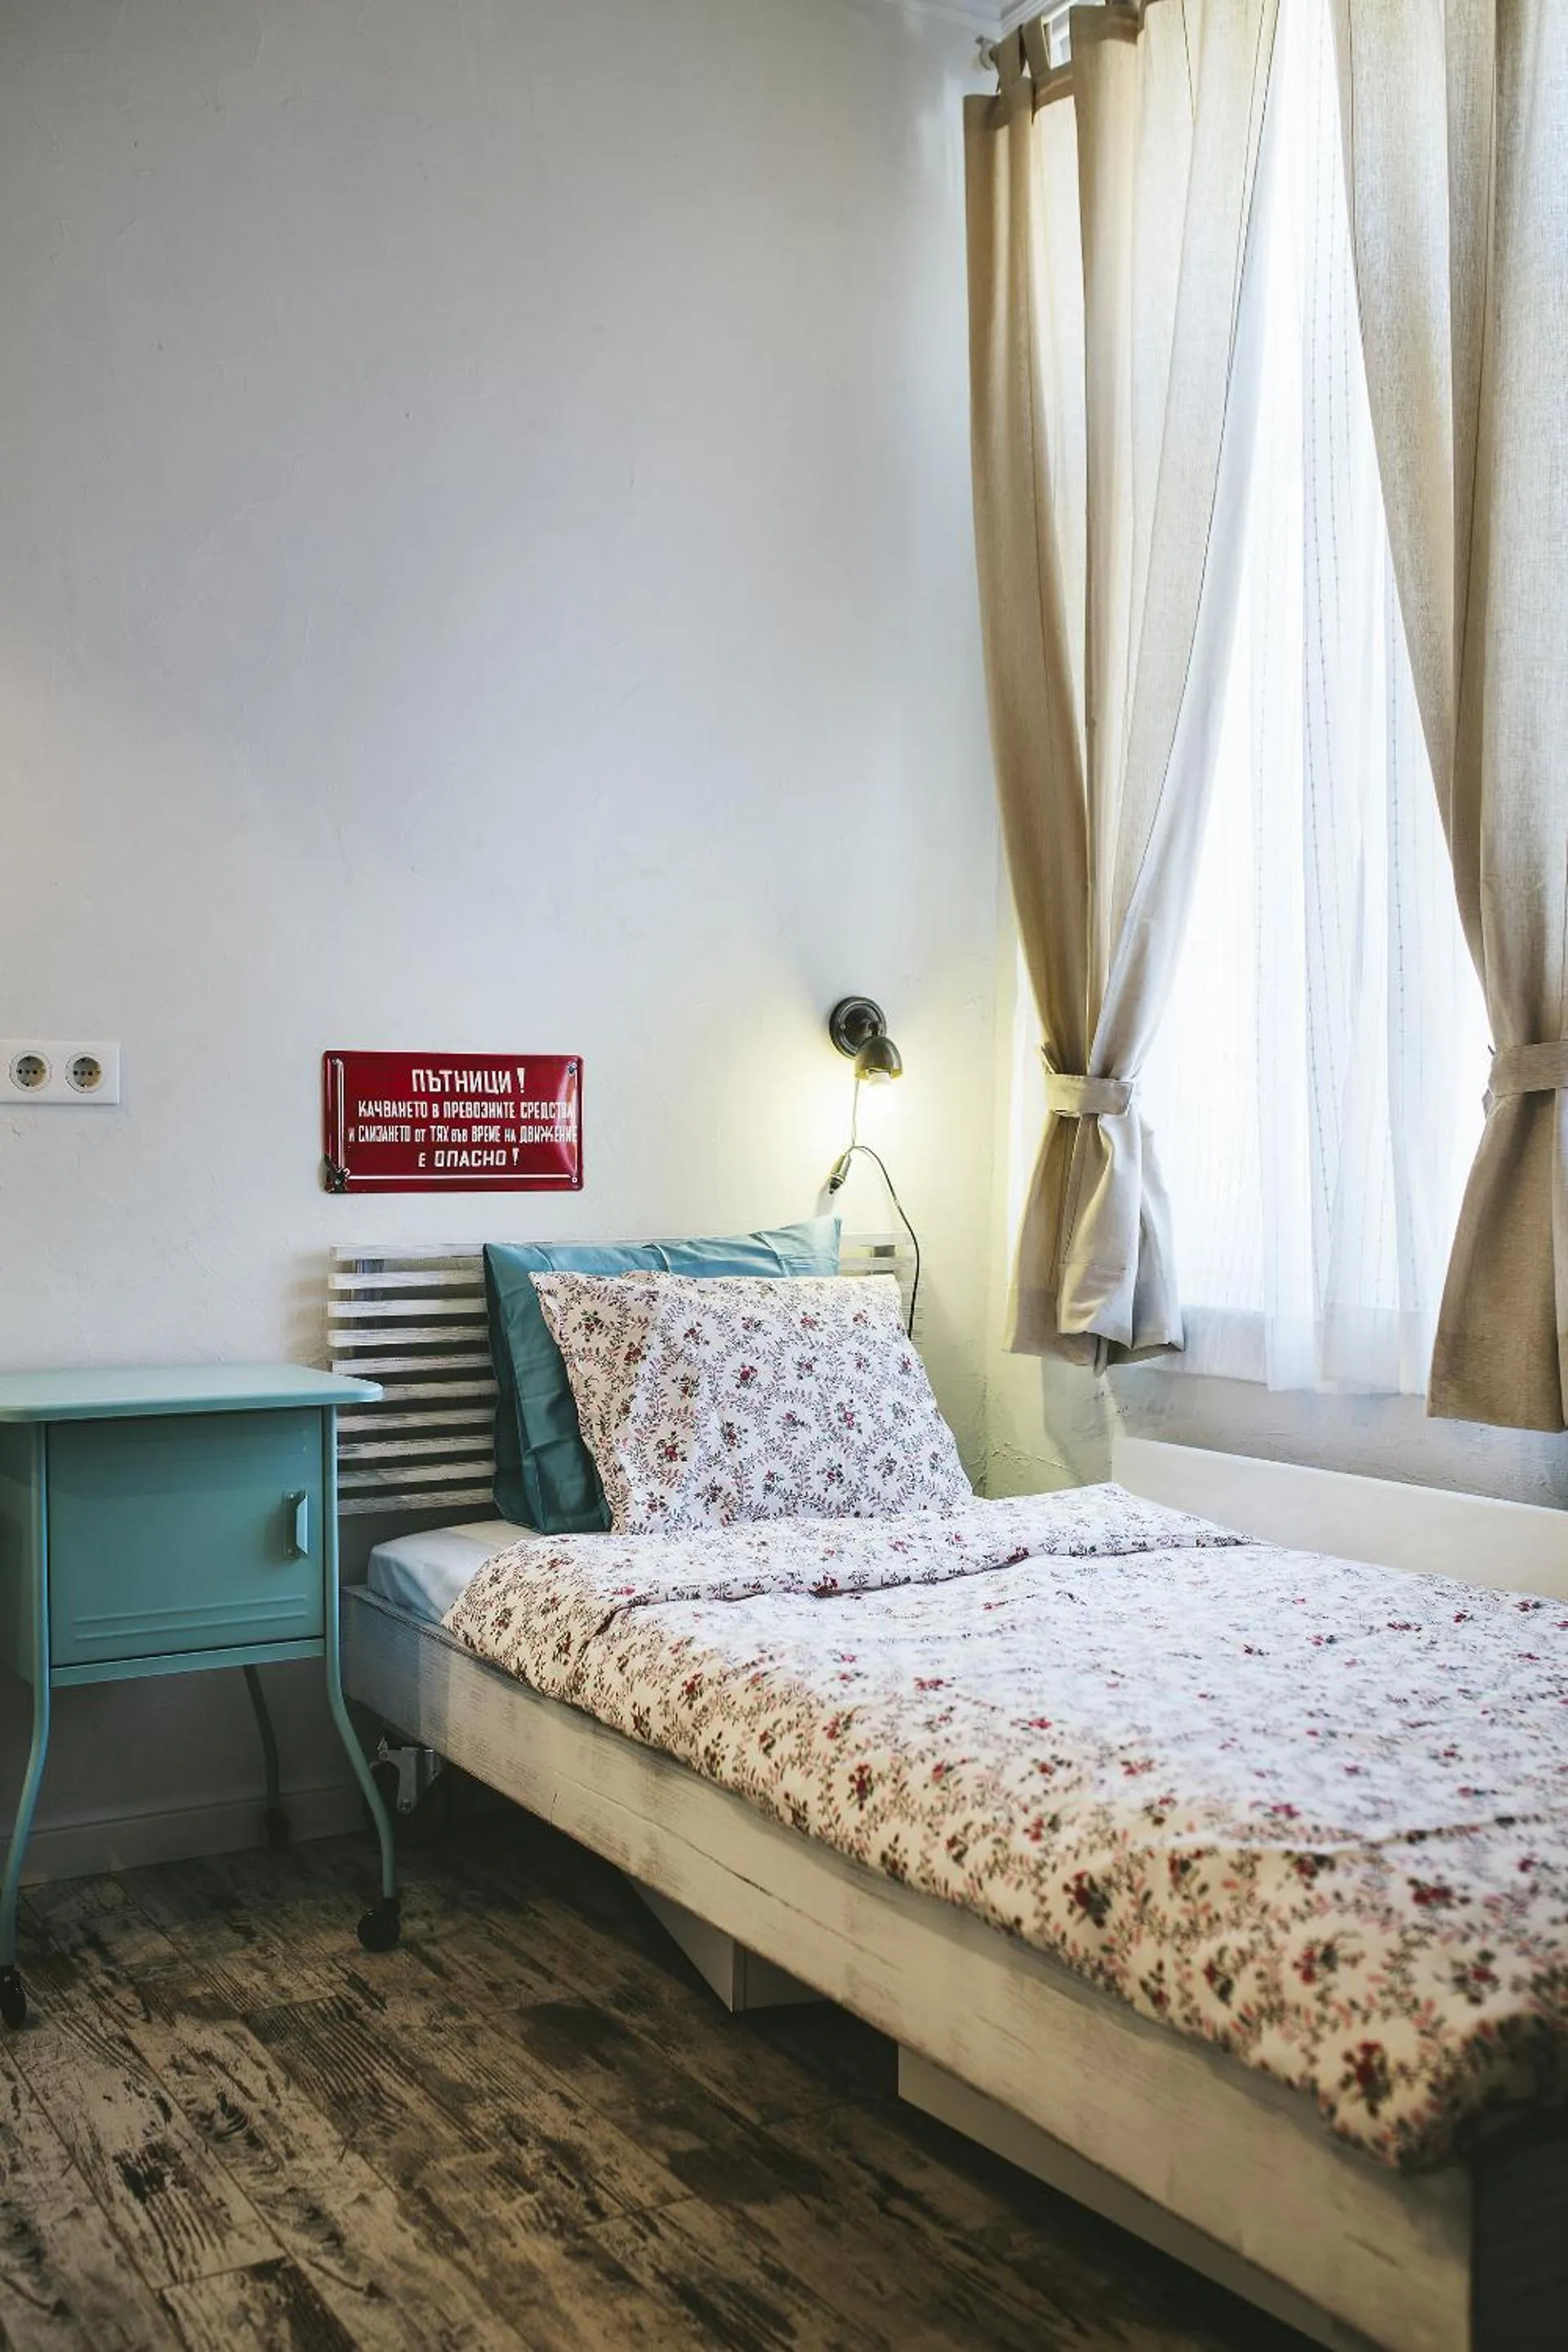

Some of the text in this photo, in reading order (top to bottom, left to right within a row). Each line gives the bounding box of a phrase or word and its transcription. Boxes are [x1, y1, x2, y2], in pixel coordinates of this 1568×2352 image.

[359, 1100, 428, 1119] КАЧВАНЕТО
[443, 1101, 516, 1119] ПРЕВОЗНИТЕ
[520, 1101, 575, 1120] СРЕДСТВА
[359, 1125, 411, 1143] СЛИЗАНЕТО
[430, 1125, 449, 1143] ТЯХ
[471, 1125, 501, 1143] ВРЕМЕ
[519, 1125, 577, 1143] ДВИЖЕНИЕ
